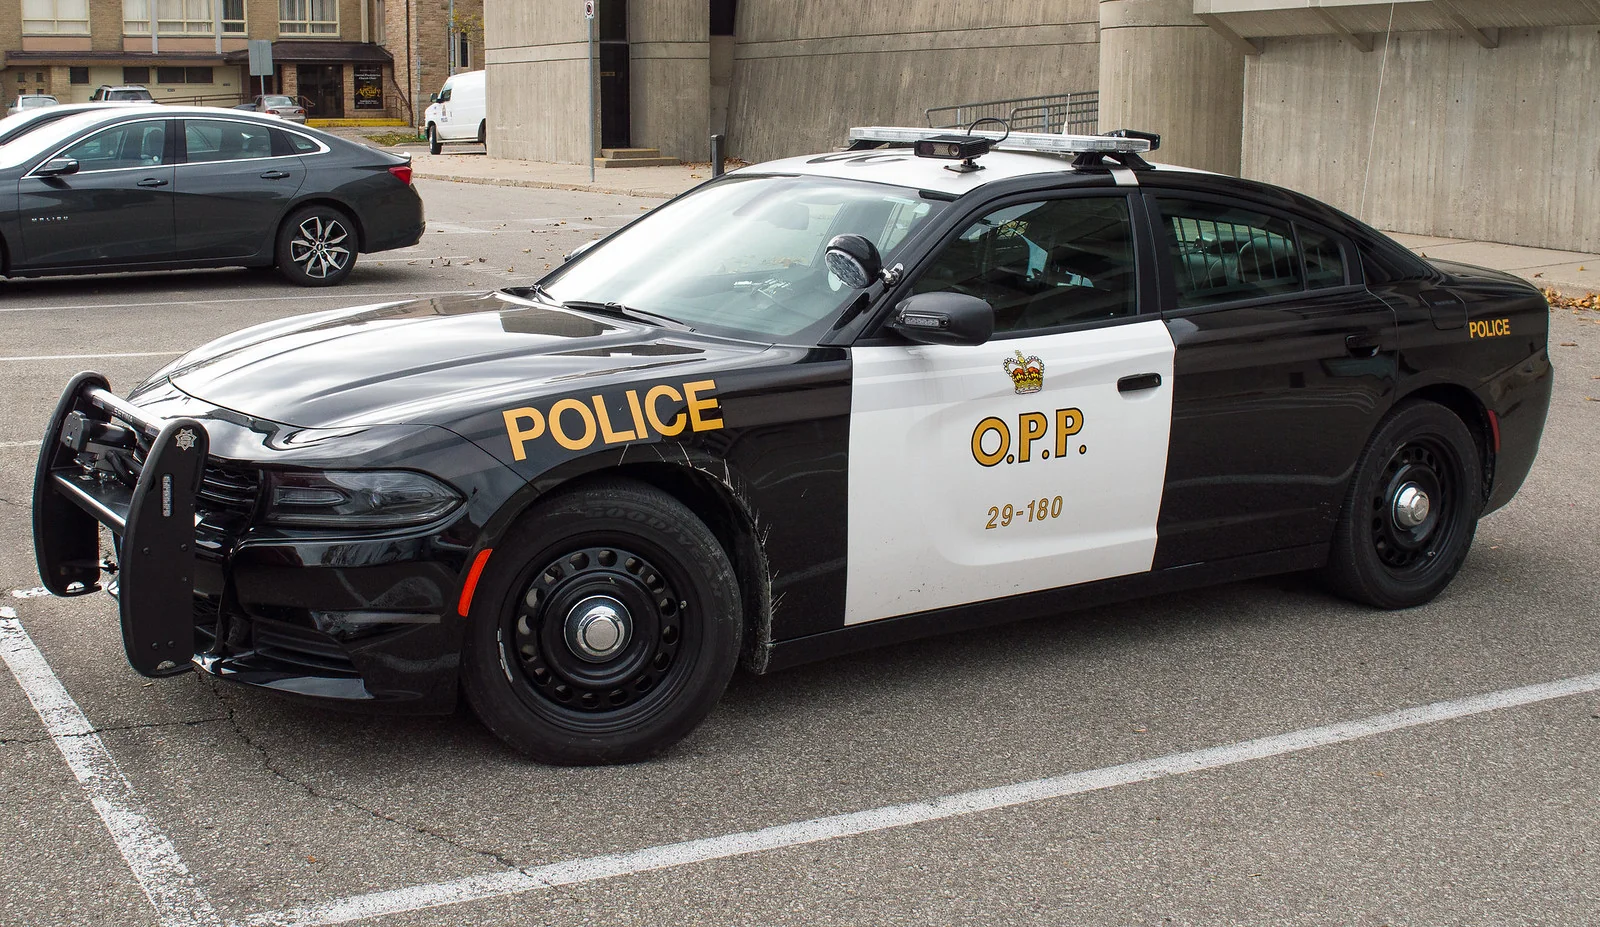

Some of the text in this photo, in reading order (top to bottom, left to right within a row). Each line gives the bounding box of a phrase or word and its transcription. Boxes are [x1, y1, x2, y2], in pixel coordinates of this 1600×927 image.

[1469, 319, 1510, 338] POLICE
[502, 379, 724, 462] POLICE
[970, 407, 1087, 467] O.P.P.
[985, 495, 1063, 530] 29-180
